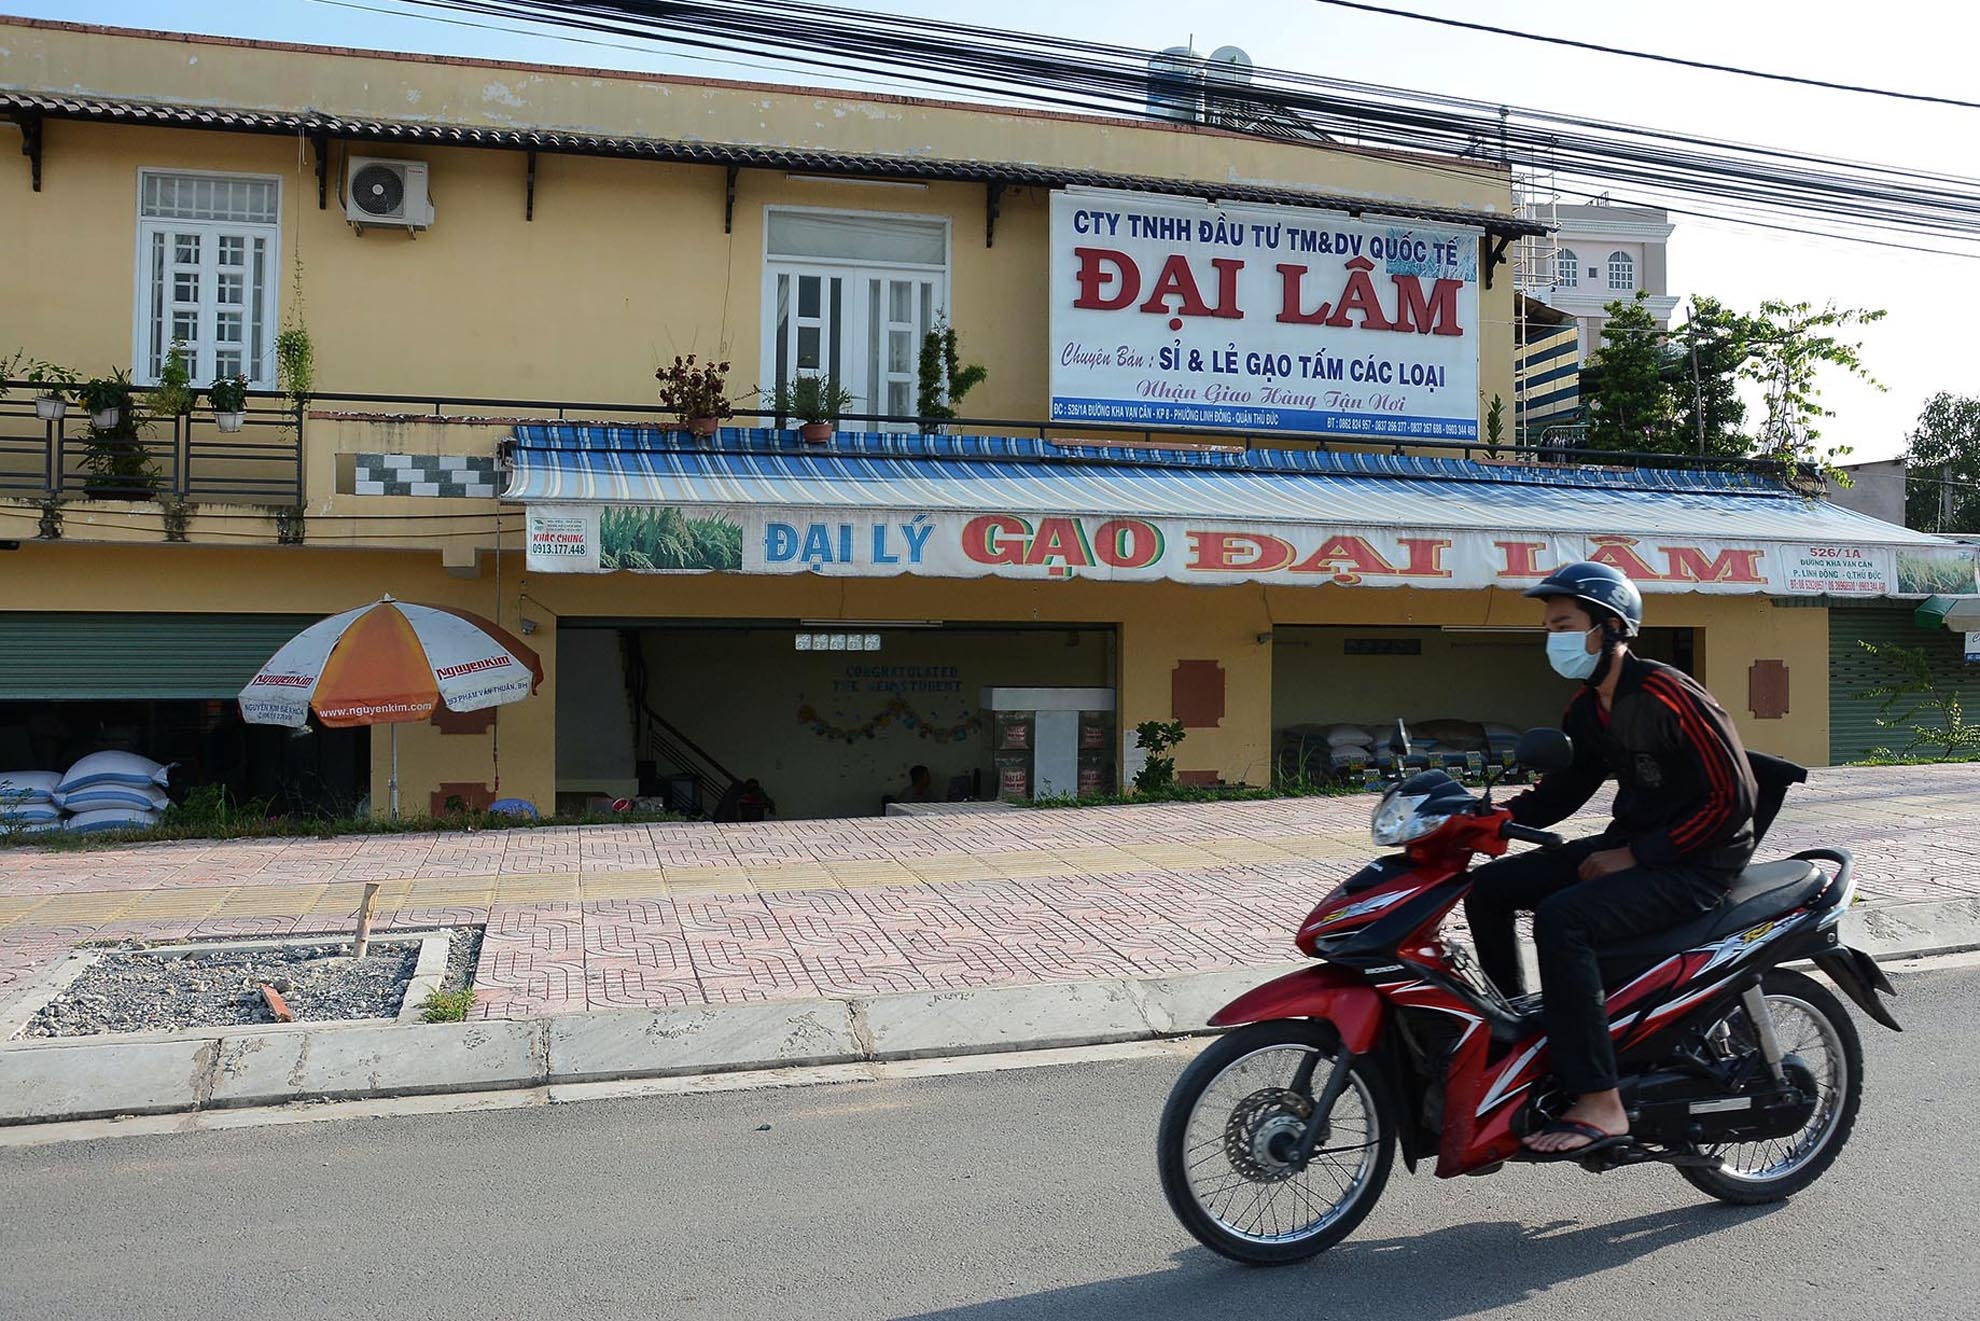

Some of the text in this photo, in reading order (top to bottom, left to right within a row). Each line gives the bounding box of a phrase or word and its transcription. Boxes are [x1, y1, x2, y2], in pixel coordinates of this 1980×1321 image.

[1074, 210, 1458, 267] CTY TNHH ĐẦU TƯ TM&DV QUỐC TẾ
[1073, 247, 1464, 336] ĐẠI LÂM
[1061, 341, 1112, 370] Chuyên
[1116, 345, 1145, 369] Bán
[1159, 338, 1181, 371] SỈ
[1187, 348, 1204, 373] &
[1212, 342, 1239, 375] LẺ
[1246, 352, 1292, 383] GẠO
[1298, 347, 1344, 381] TẤM
[1350, 354, 1393, 384] CÁC
[1399, 362, 1446, 393] LOẠI
[1136, 378, 1407, 413] Nhận Giao Hàng Tận Nơi
[1111, 405, 1124, 418] KHA
[1199, 410, 1214, 422] LINH
[532, 543, 586, 555] 0913.177.448
[556, 533, 585, 543] CHUNG
[762, 513, 1768, 585] ĐẠI LÝ GẠO ĐẠI LÂM
[320, 703, 432, 717] www.nguyenkim.com
